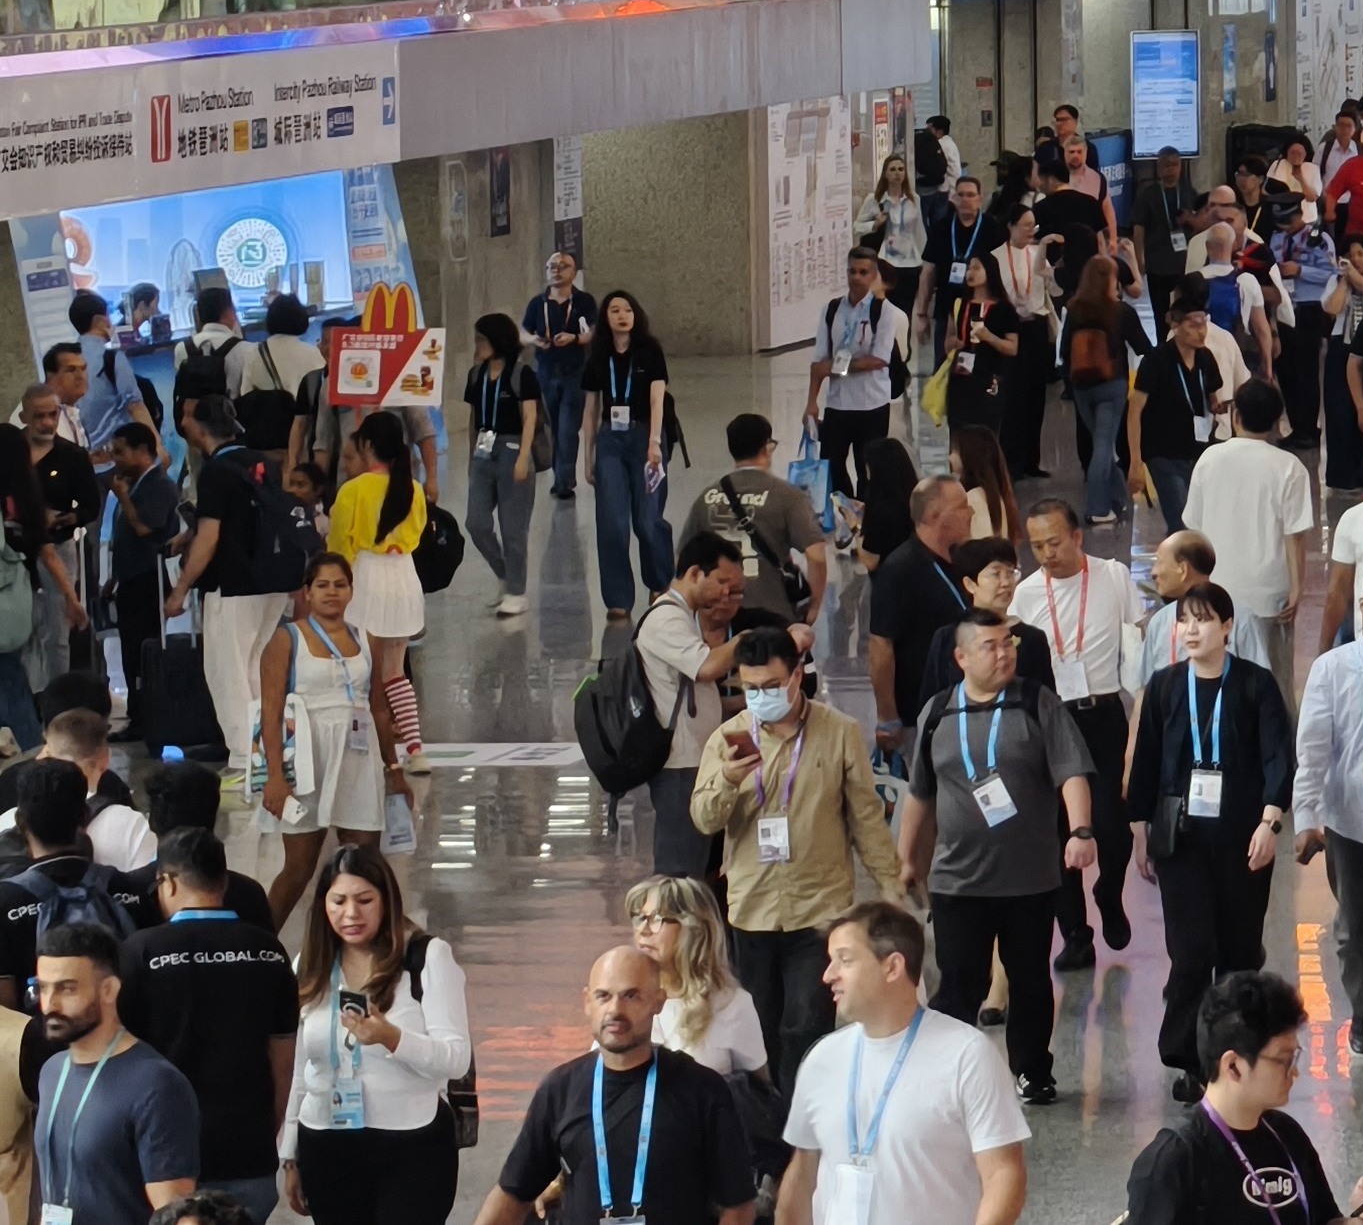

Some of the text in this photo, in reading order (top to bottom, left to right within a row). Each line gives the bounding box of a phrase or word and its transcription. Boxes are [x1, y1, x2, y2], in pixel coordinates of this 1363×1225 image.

[354, 74, 377, 93] Station
[228, 86, 253, 109] Station
[704, 488, 769, 507] Grnd
[149, 949, 285, 970] CPEC GLOBAL.COM
